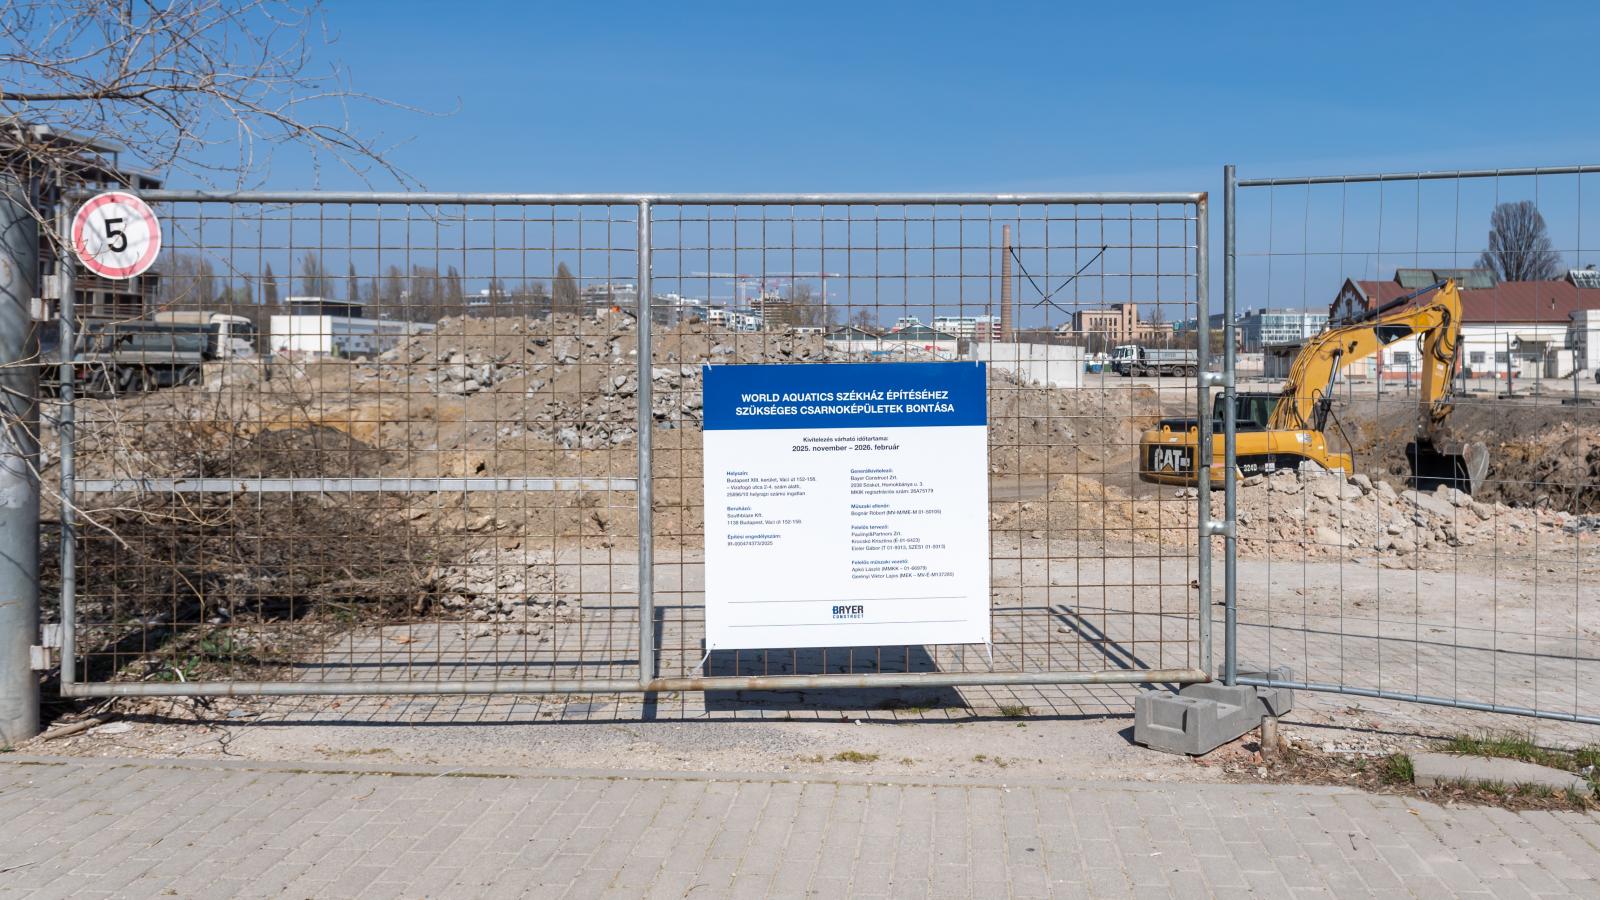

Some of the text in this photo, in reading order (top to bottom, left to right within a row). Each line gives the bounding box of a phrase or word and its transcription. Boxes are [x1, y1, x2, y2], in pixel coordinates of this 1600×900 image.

[105, 218, 127, 252] 5
[742, 390, 949, 403] WORLD AQUATICS SZÉKHÁZ ÉPÍTÉSÉHEZ
[736, 402, 954, 416] SZÜKSÉGES CSARNOKÉPÜLETEK BONTÁSA
[1154, 448, 1182, 474] CAT
[832, 605, 863, 614] BAYER
